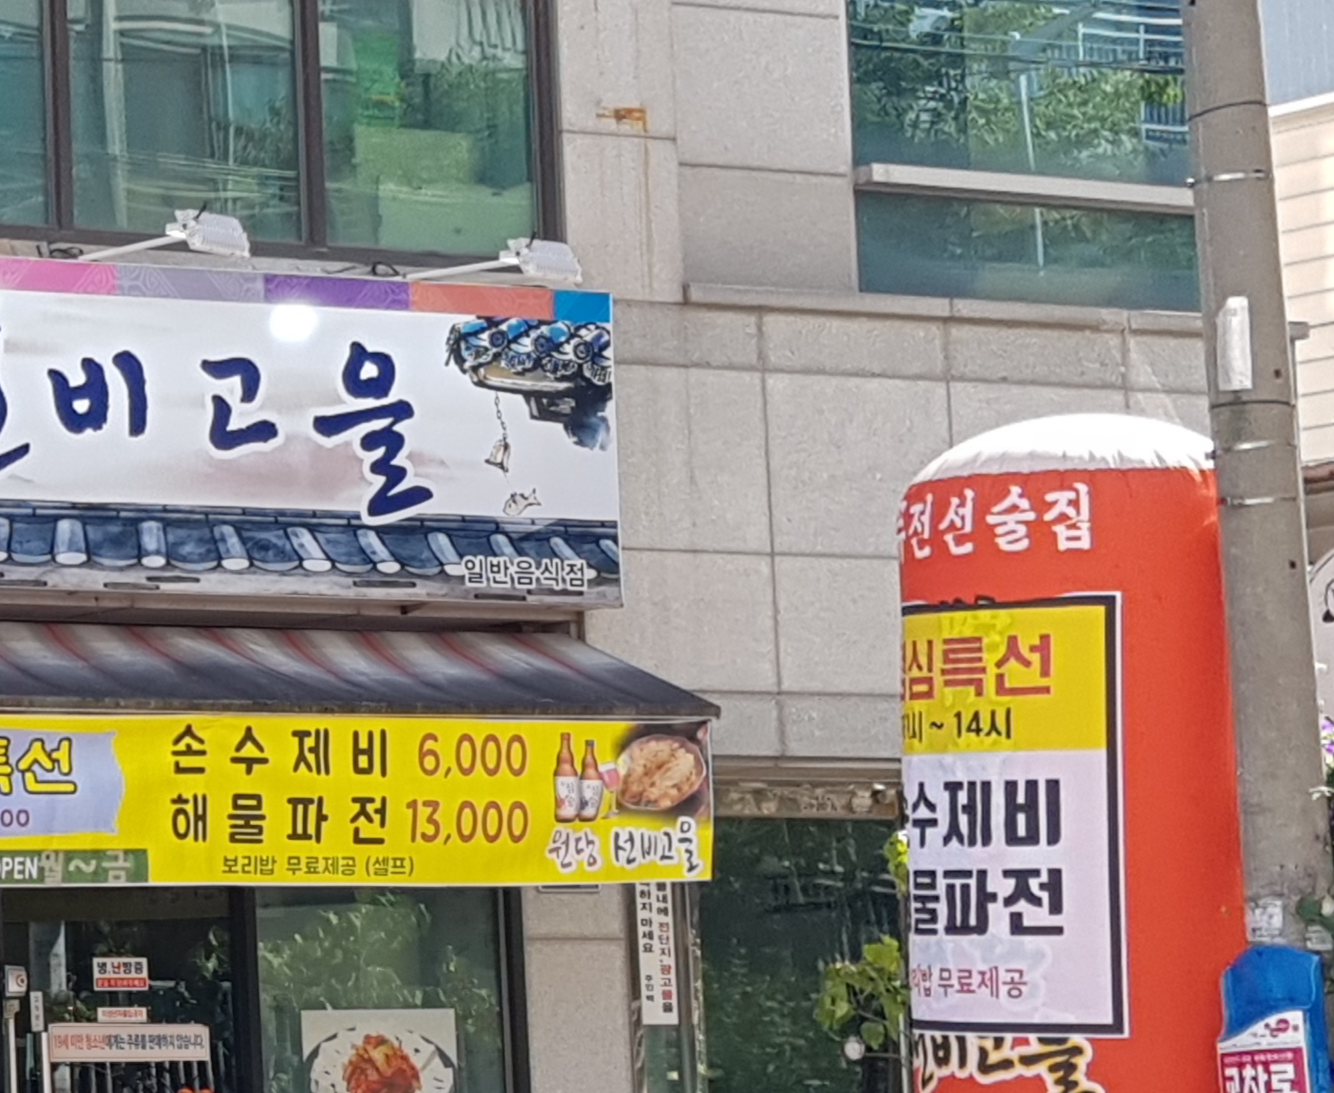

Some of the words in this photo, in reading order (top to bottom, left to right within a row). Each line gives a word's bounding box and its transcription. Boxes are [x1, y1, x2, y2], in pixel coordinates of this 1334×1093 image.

[463, 557, 586, 589] 일반음식점
[902, 634, 1052, 700] 심특선
[954, 707, 1012, 740] 14시
[170, 723, 388, 778] 손수제비
[417, 732, 528, 779] 6,000
[170, 792, 387, 845] 해물파전
[406, 798, 529, 846] 13,000
[909, 778, 1062, 849] 수제비
[221, 855, 277, 876] 보리밥
[285, 855, 357, 876] 무료제공
[365, 855, 415, 878] (셀프)
[548, 830, 598, 869] 원당
[613, 821, 699, 873] 선비고을
[910, 868, 1065, 936] 물파전
[640, 918, 655, 954] 마세요
[912, 963, 933, 998] 리밥
[937, 966, 1028, 999] 무료제공
